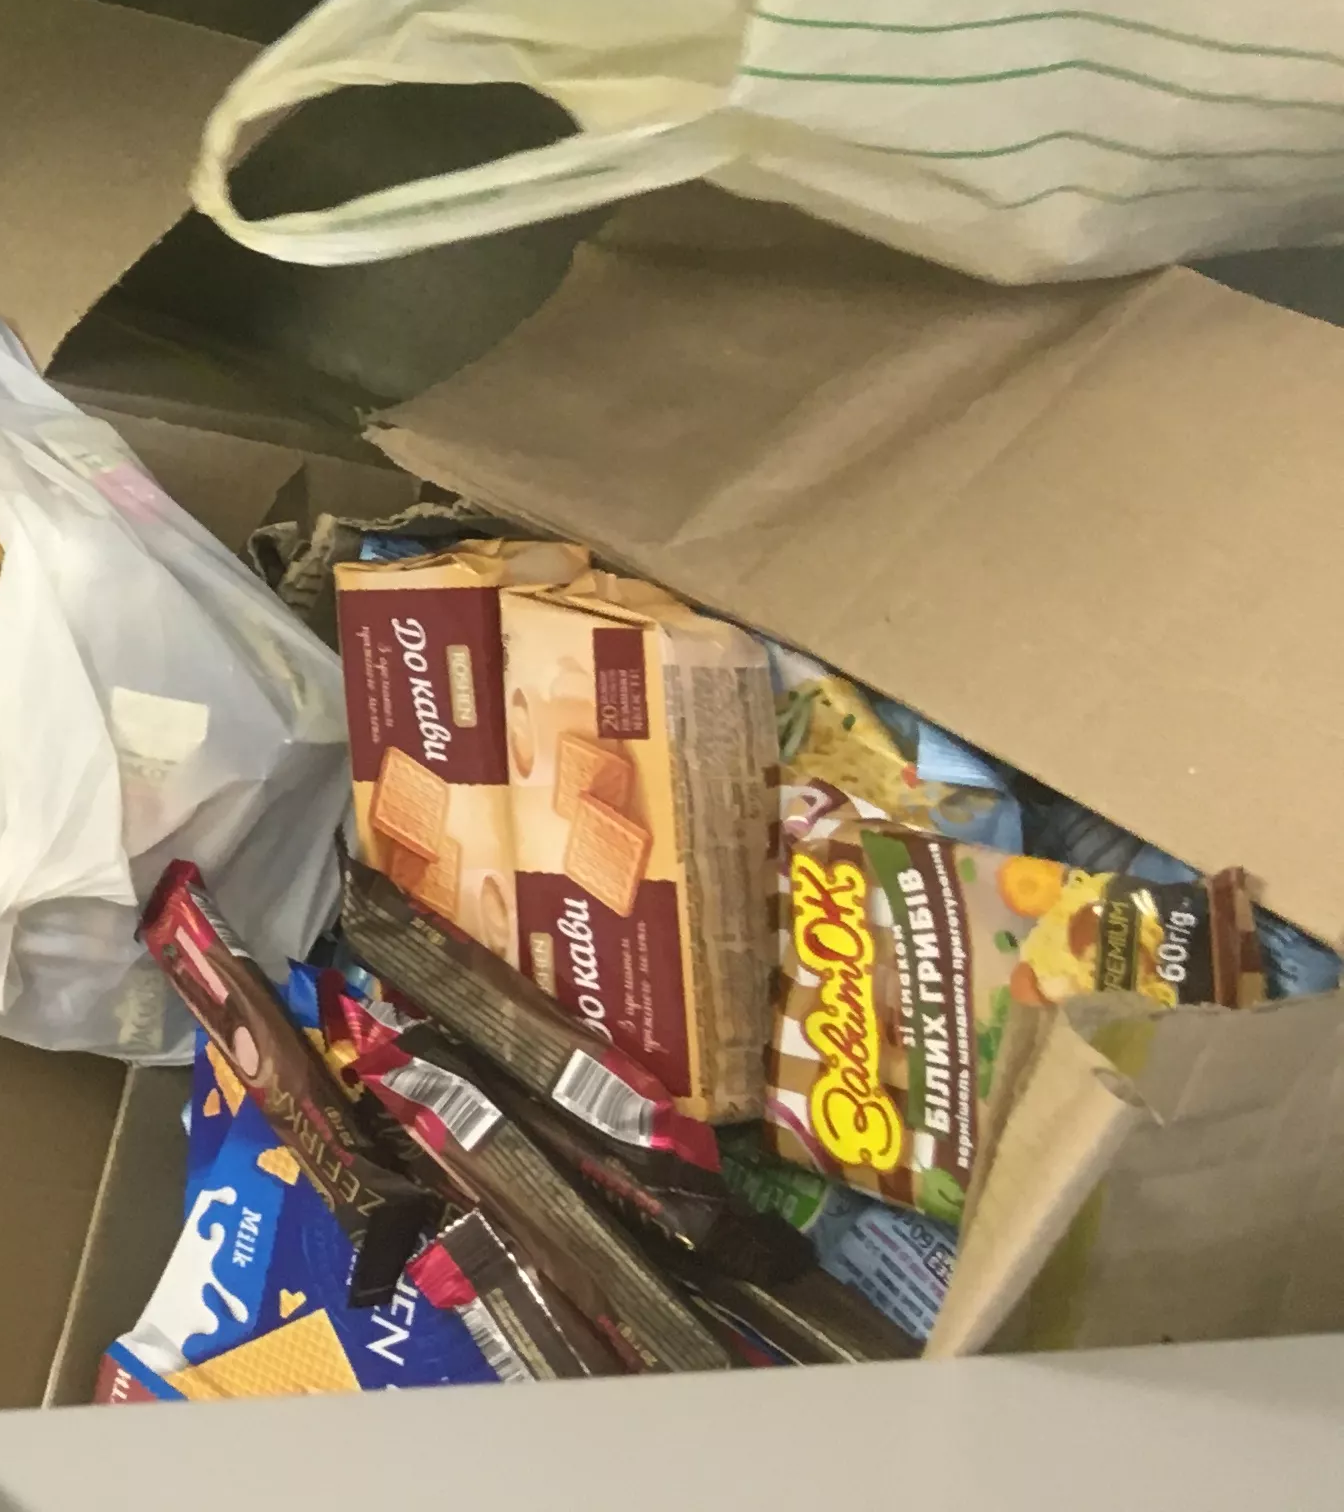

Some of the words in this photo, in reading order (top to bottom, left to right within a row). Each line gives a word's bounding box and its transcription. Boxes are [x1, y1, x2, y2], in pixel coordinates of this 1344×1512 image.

[409, 676, 452, 763] кави
[556, 897, 601, 991] кави
[896, 866, 945, 1005] ГРИБІВ
[1103, 900, 1130, 990] REMIUM
[921, 1013, 951, 1134] БІЛИХ
[272, 1074, 386, 1218] ZEFIRKA
[231, 1207, 262, 1268] Milk
